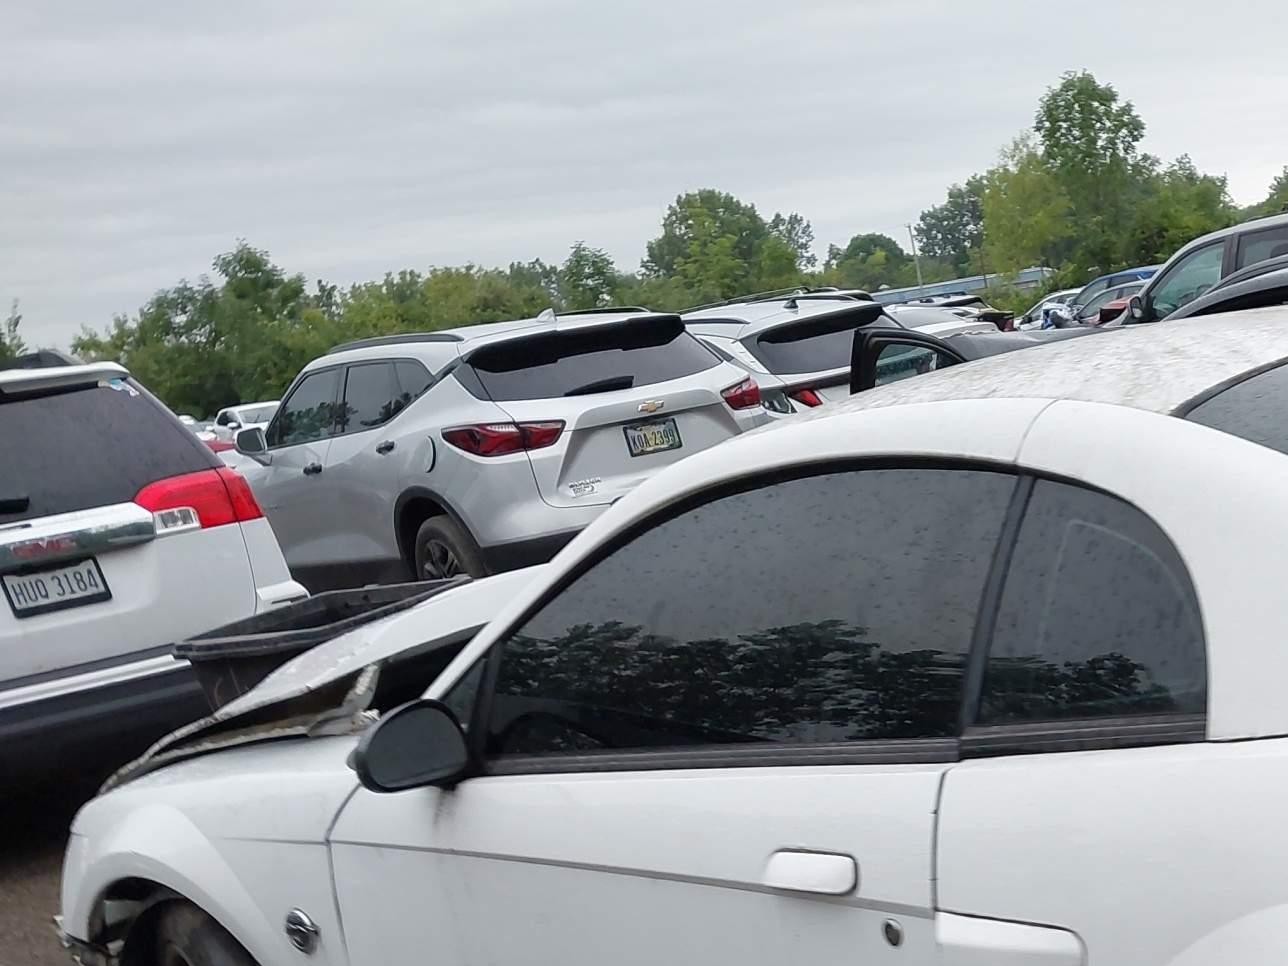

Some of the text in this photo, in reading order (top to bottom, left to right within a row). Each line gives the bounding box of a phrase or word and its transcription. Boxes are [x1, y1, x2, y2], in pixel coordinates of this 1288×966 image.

[652, 428, 675, 446] 2399
[11, 567, 99, 605] HUQ 3184
